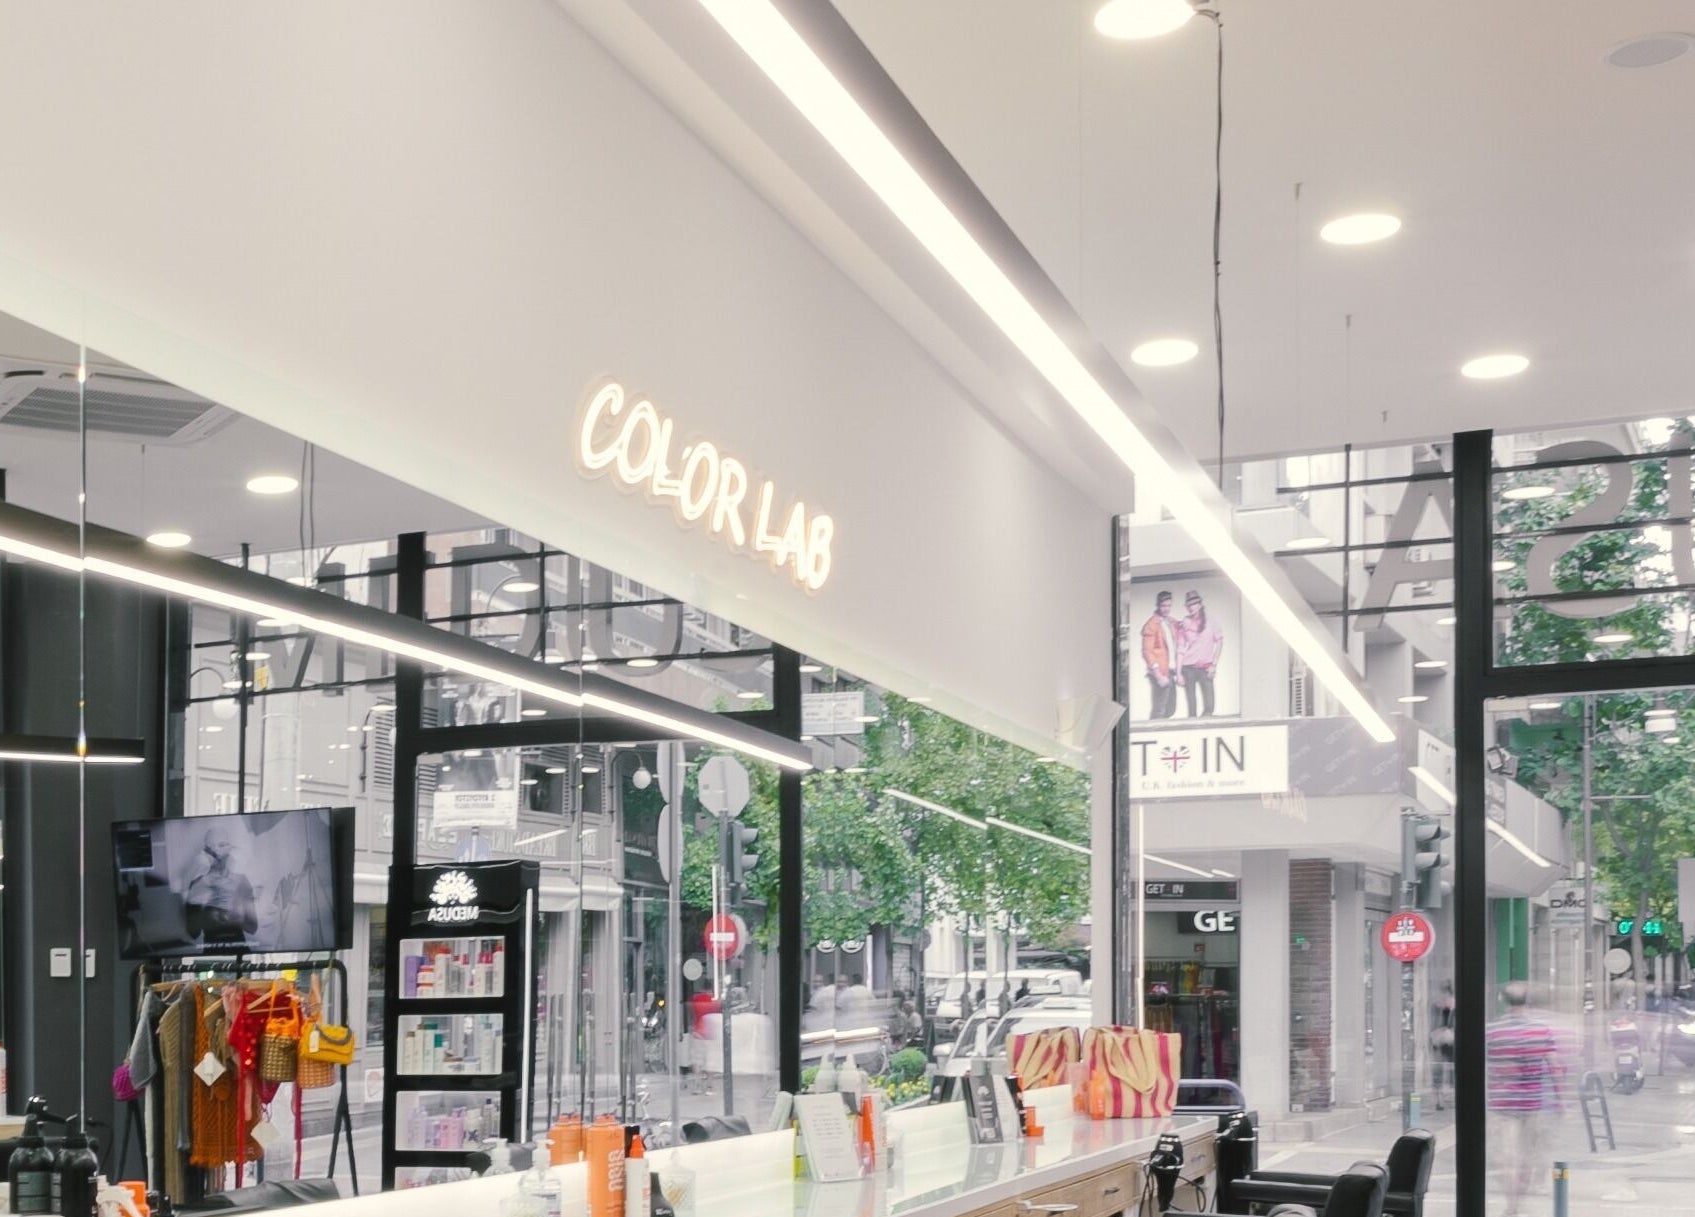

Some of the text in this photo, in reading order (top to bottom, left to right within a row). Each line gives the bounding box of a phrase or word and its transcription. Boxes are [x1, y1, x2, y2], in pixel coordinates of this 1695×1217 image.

[579, 382, 834, 590] COLOR LAB
[1145, 883, 1185, 895] GET IN
[1193, 909, 1236, 933] GE
